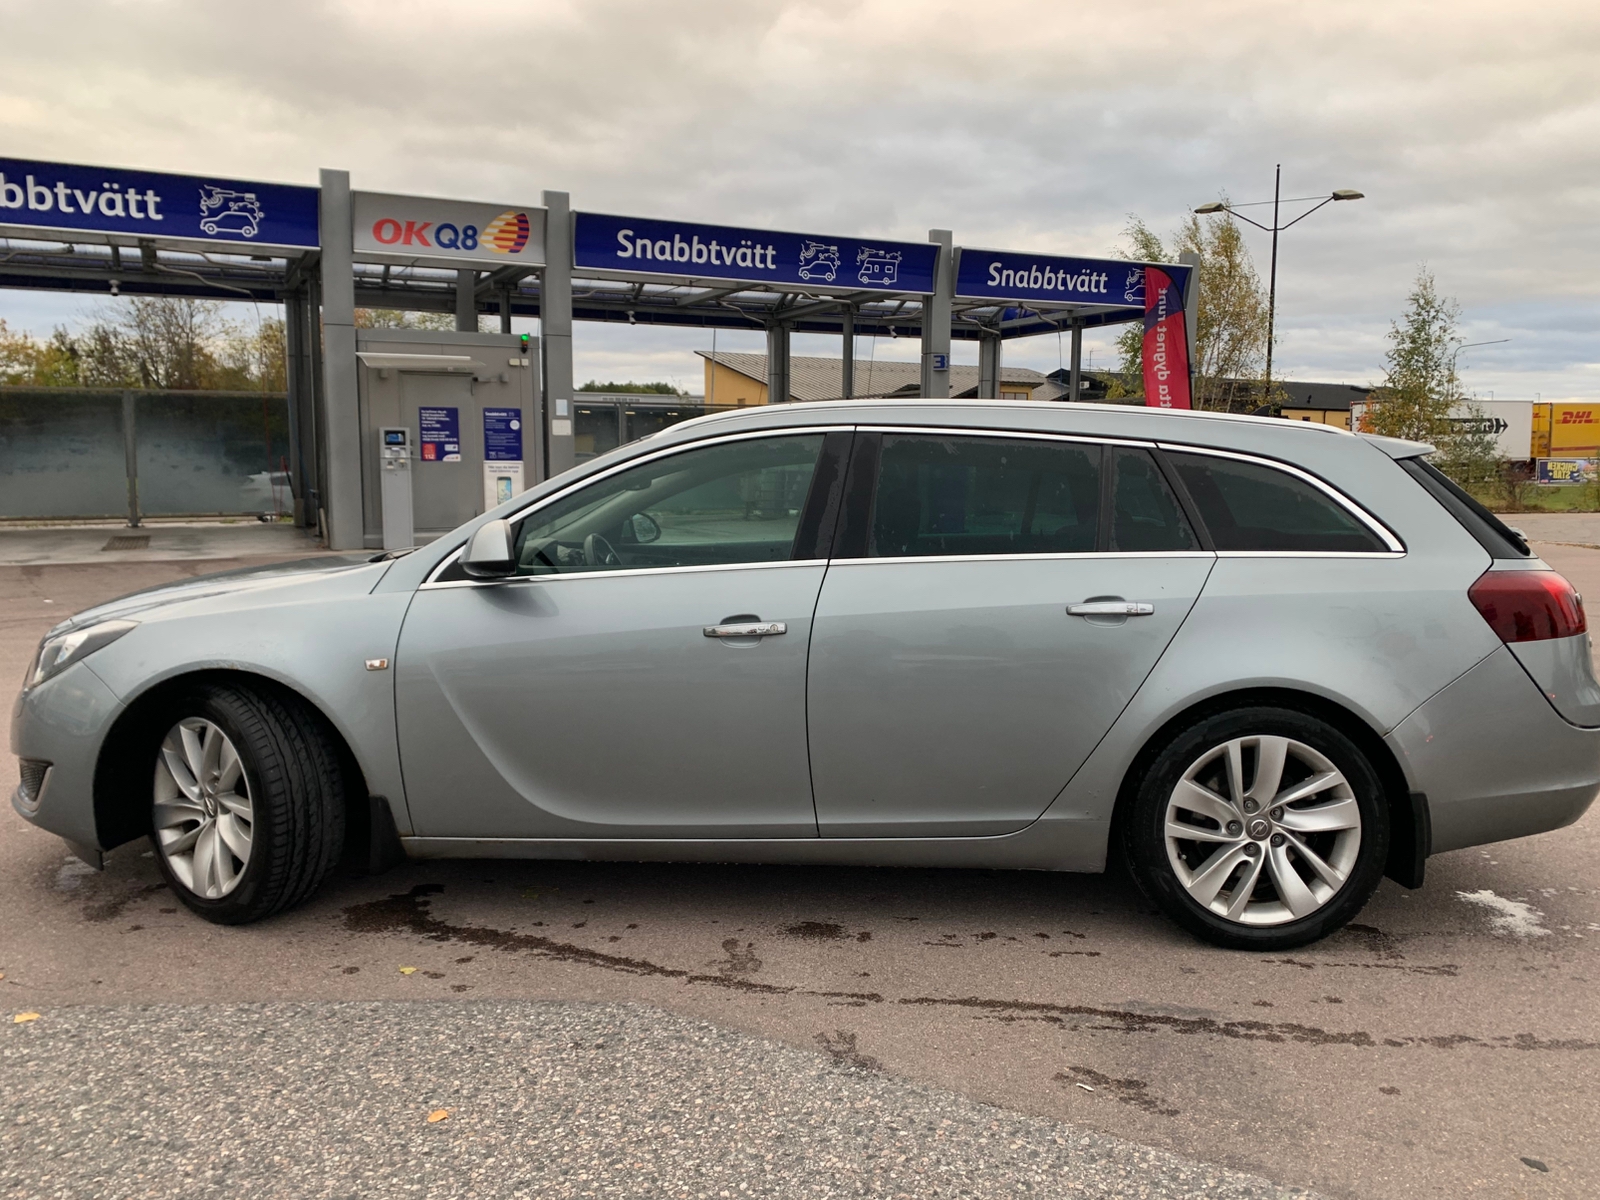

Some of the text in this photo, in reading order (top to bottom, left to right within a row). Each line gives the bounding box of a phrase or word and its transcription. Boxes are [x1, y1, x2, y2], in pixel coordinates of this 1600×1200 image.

[0, 172, 163, 220] bbtvätt
[372, 218, 478, 251] OKQ8
[616, 229, 777, 269] Snabbtvätt
[987, 262, 1108, 293] Snabbtvätt
[933, 354, 946, 369] 3
[1561, 411, 1594, 424] DHL
